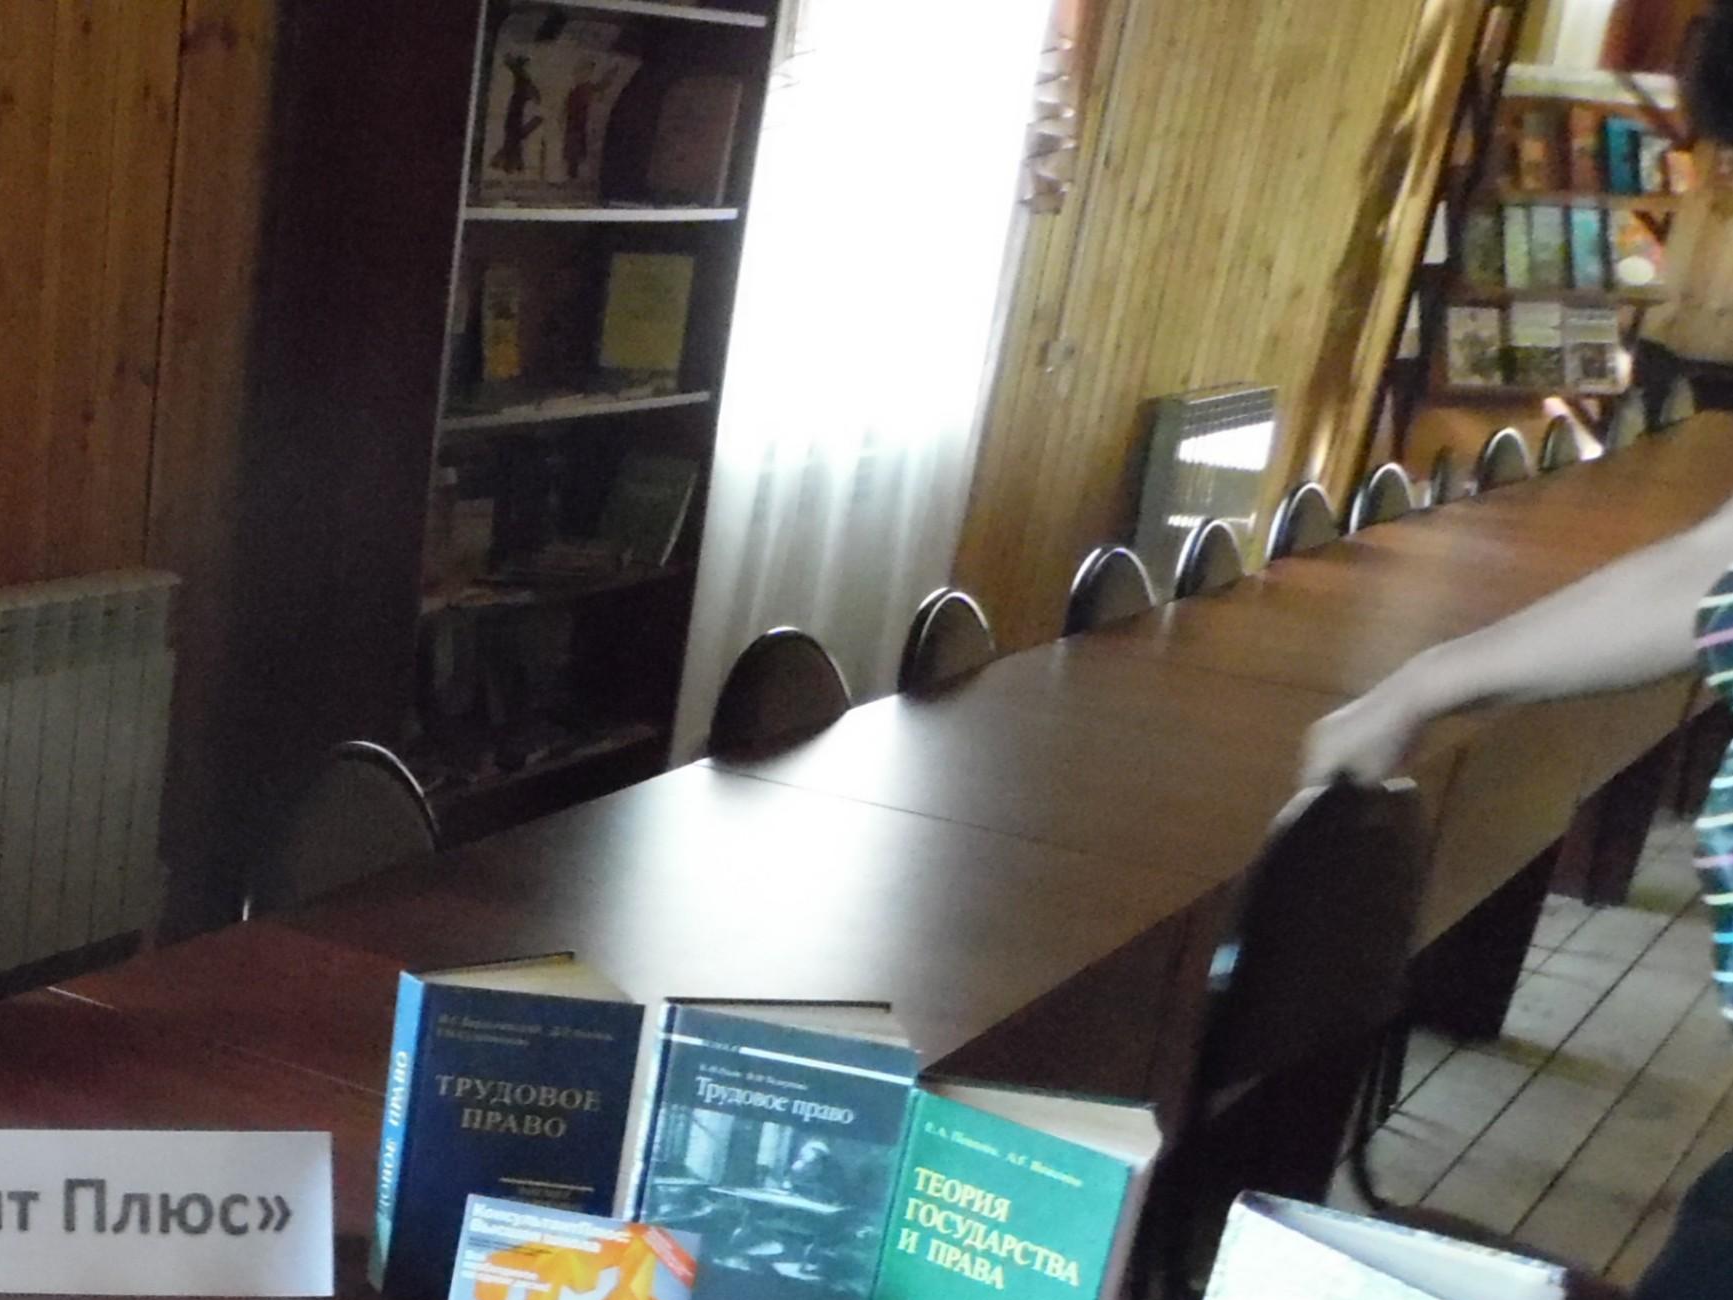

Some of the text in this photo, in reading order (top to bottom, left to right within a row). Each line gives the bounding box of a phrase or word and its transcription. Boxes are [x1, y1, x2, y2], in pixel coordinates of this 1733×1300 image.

[436, 1074, 602, 1111] ТРУДОВОЕ
[695, 1075, 788, 1111] Трудовое
[791, 1100, 855, 1125] право
[461, 1108, 566, 1138] ПРАВО
[63, 1178, 293, 1236] Плюс»
[915, 1167, 1011, 1223] ТЕОРИЯ
[897, 1228, 1005, 1290] И ПРАВА
[905, 1198, 1080, 1287] ГОСУДАРСТВА
